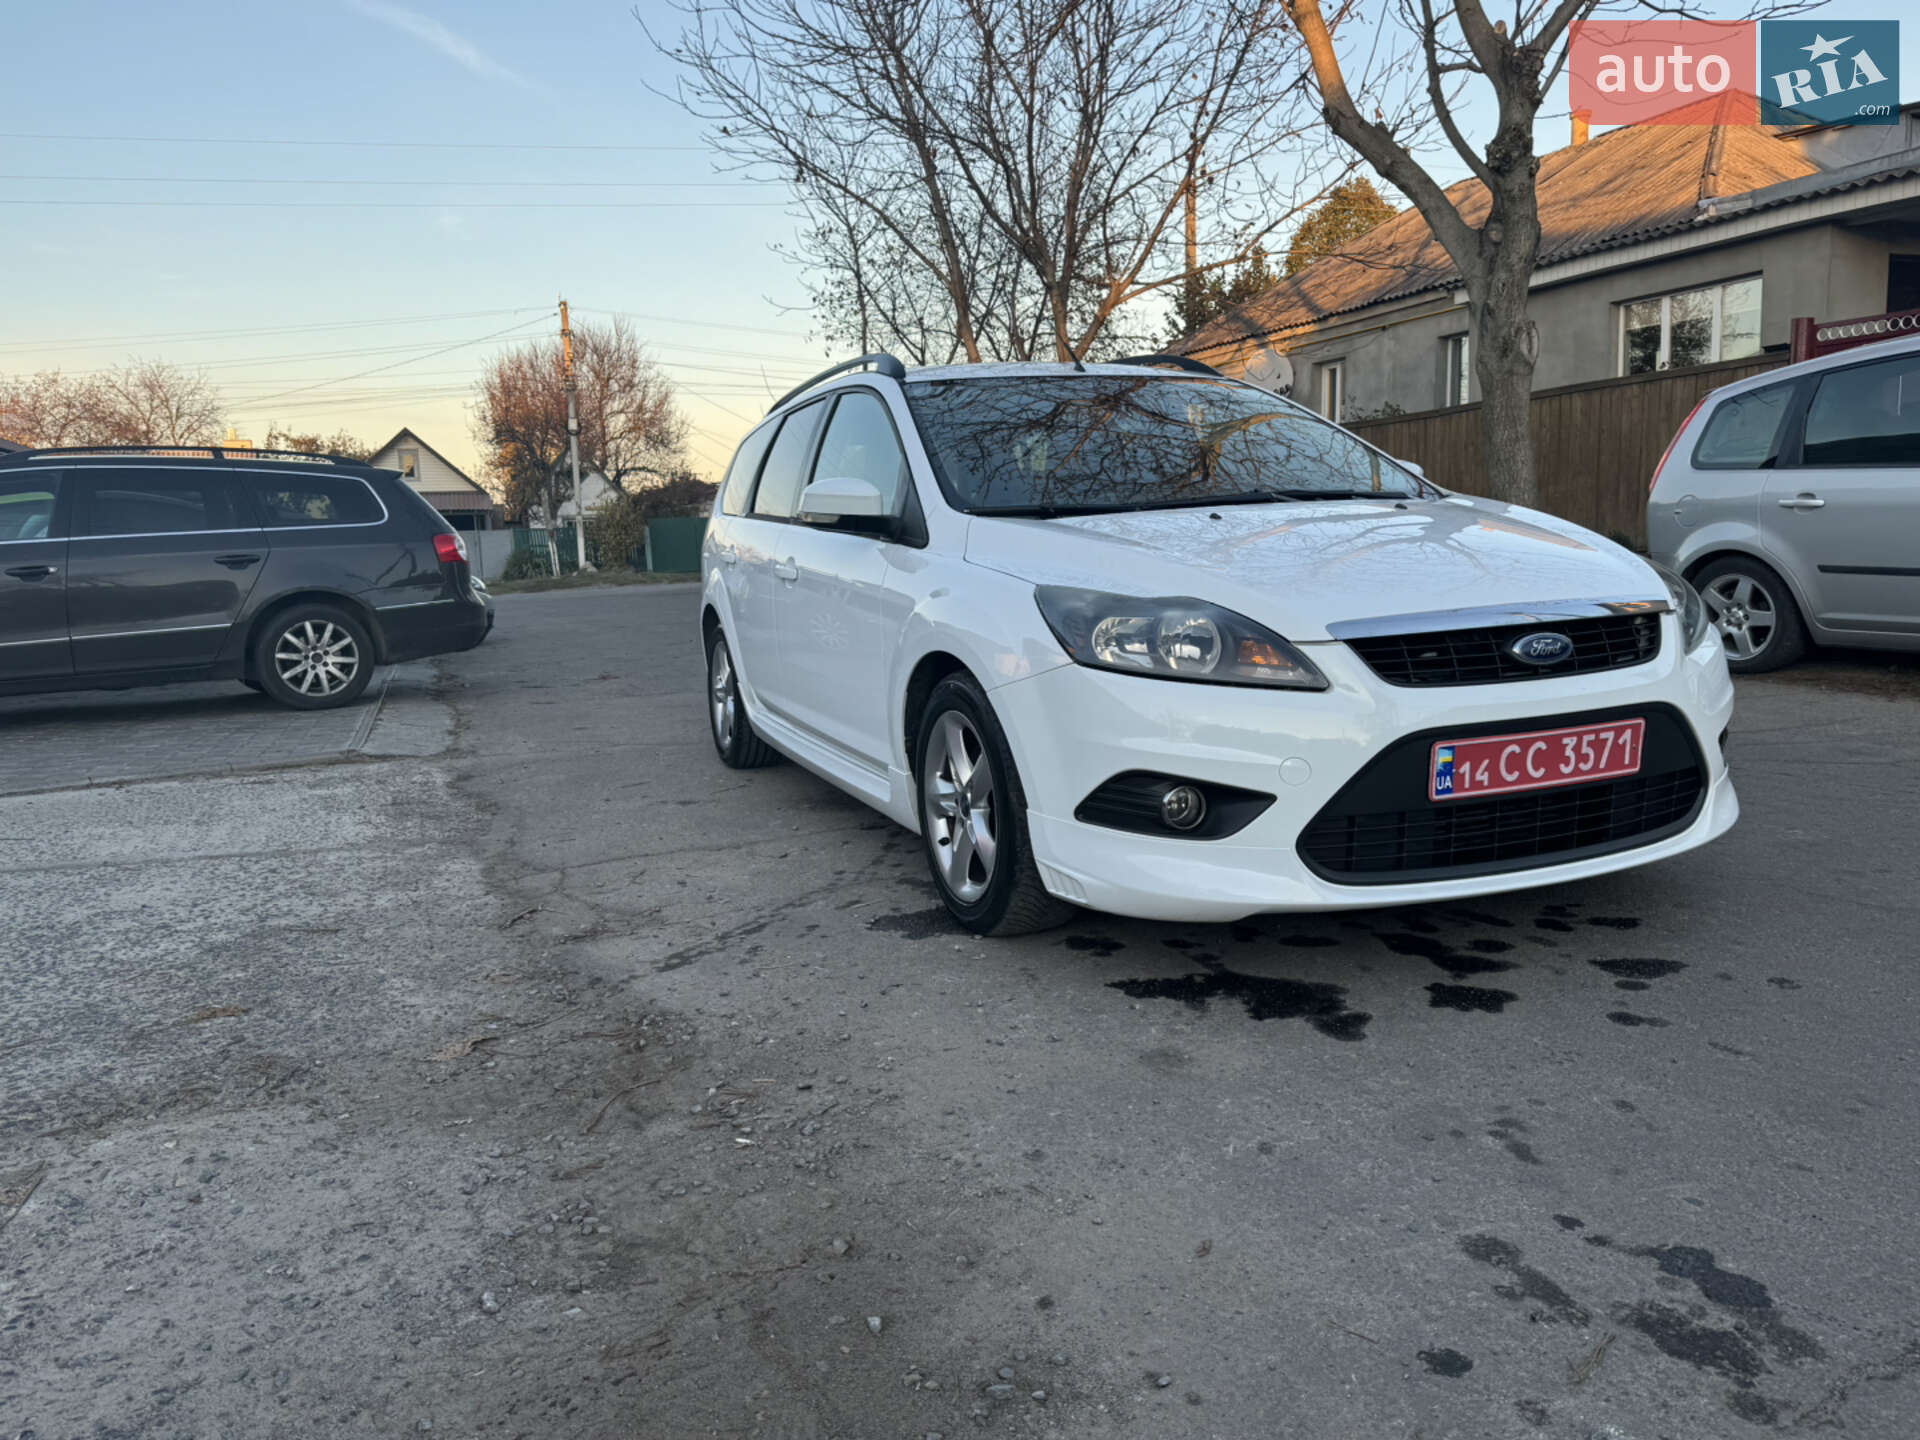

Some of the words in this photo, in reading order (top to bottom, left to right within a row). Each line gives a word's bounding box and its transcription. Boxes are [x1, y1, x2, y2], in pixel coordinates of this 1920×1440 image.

[1530, 639, 1562, 656] Ford
[1459, 760, 1490, 789] 14
[1500, 741, 1547, 782] CC
[1559, 729, 1632, 774] 3571
[1436, 775, 1453, 790] UA
